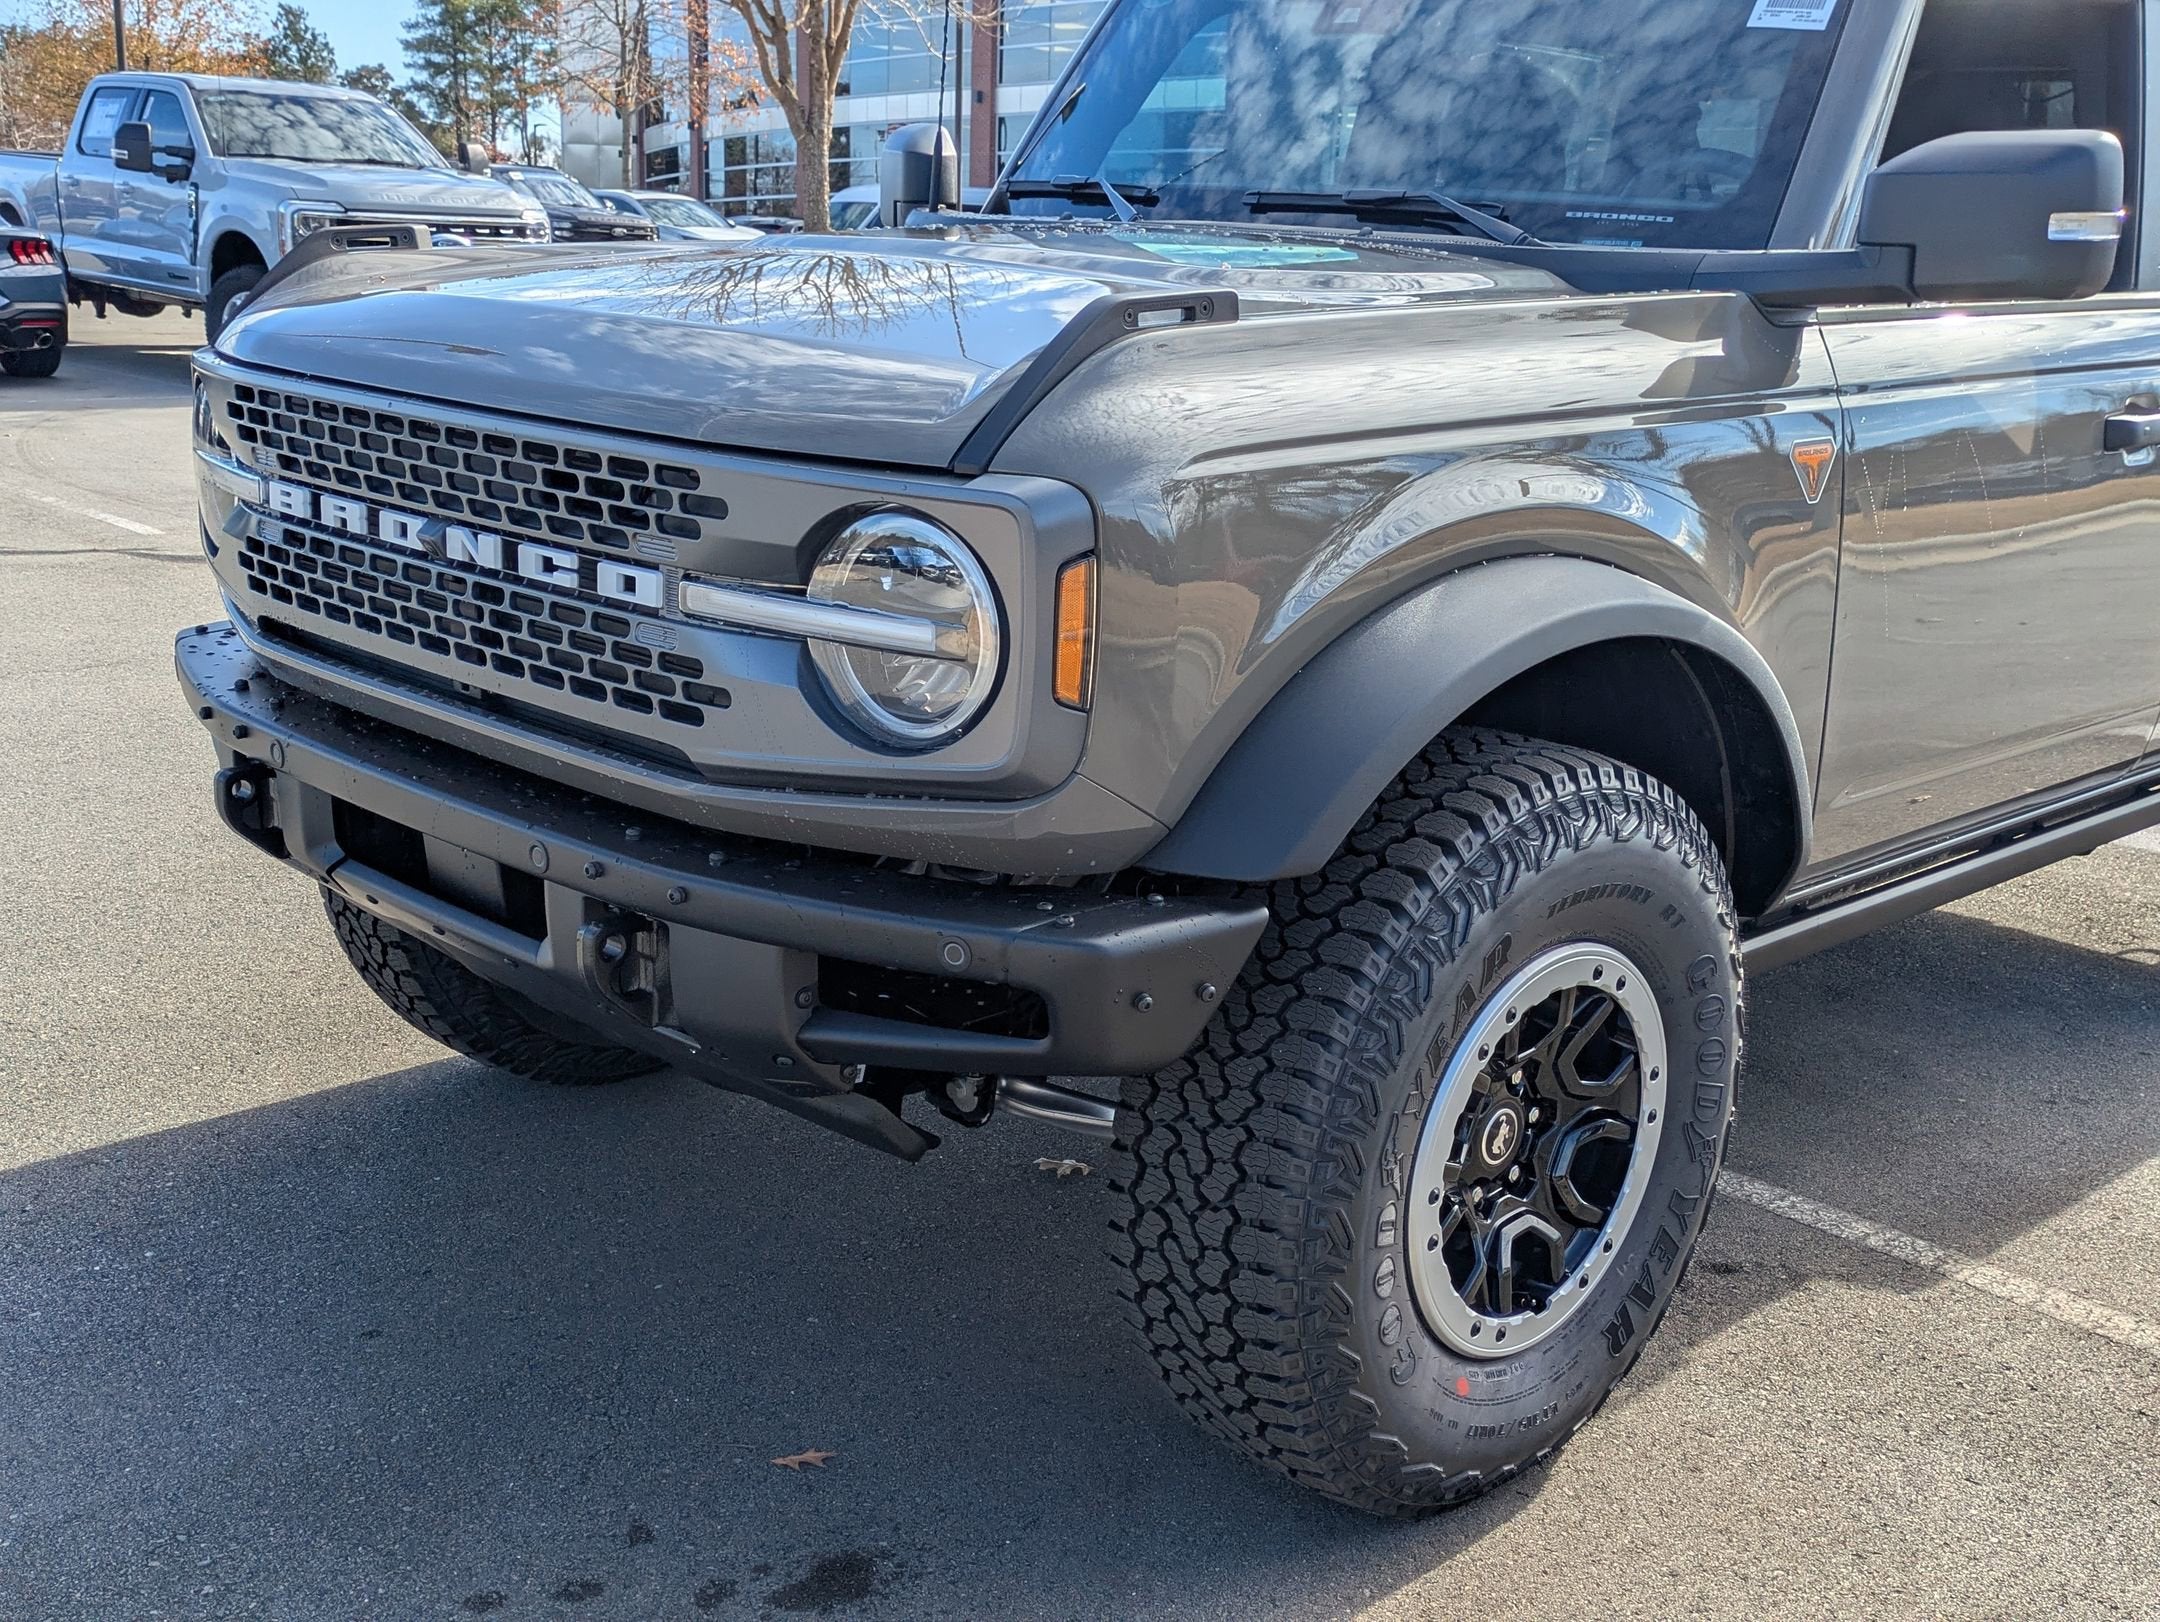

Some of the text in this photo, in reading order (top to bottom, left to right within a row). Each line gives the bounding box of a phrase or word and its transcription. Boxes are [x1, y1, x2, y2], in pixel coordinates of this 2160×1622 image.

[1565, 211, 1674, 222] BRONCO
[269, 481, 664, 609] BRONCO
[1547, 882, 1686, 929] TERRITORY RT
